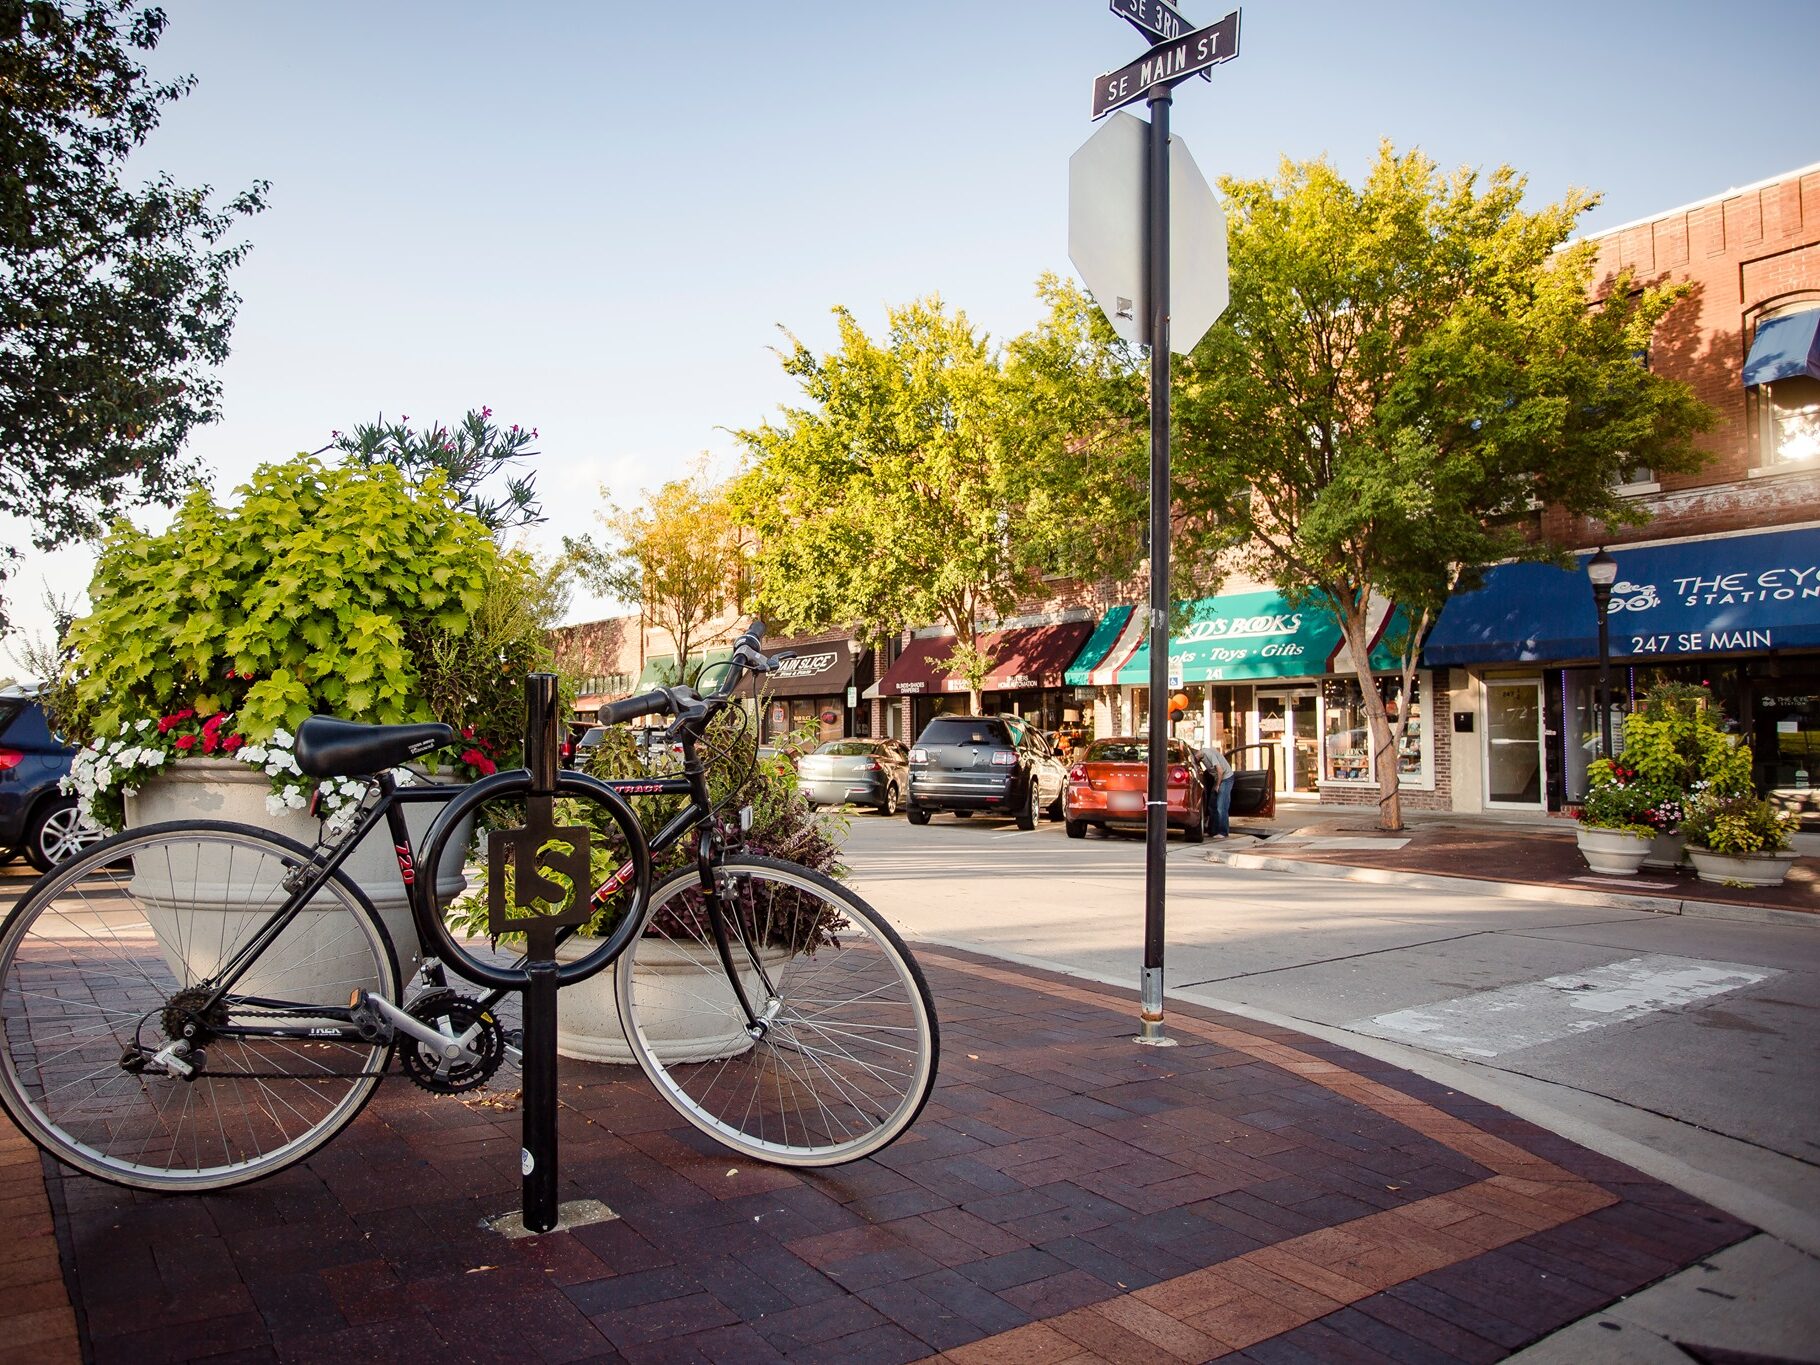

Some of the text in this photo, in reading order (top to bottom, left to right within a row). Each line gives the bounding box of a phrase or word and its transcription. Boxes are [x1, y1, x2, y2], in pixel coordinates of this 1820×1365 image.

[1130, 0, 1180, 39] SE 3RD
[1108, 32, 1220, 101] SE MAIN ST
[1673, 566, 1820, 595] THE EY
[1685, 586, 1820, 607] STATION
[1229, 613, 1302, 634] BOOKS
[1632, 630, 1771, 653] 247 SE MAIN
[798, 655, 831, 669] SLICE
[1168, 643, 1304, 663] oks Toys Gifts
[1205, 668, 1223, 680] 241
[614, 784, 664, 794] TRACK
[395, 840, 414, 885] 720
